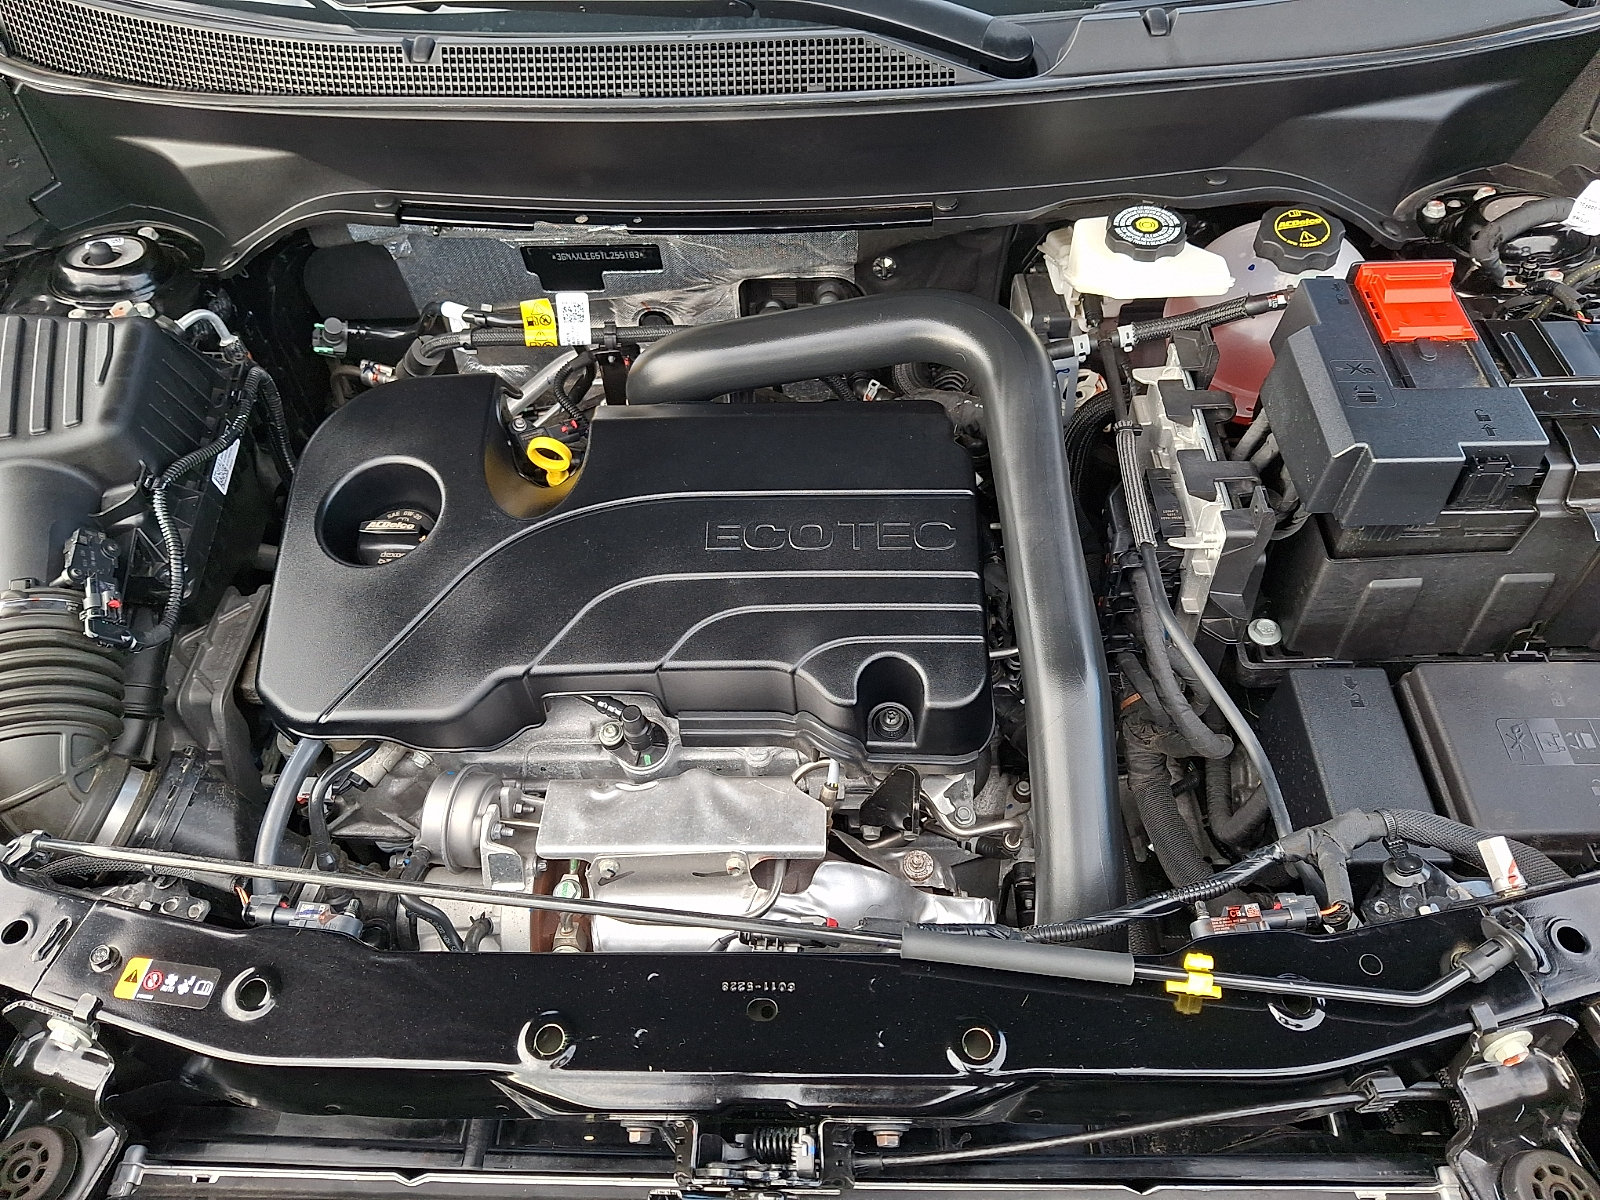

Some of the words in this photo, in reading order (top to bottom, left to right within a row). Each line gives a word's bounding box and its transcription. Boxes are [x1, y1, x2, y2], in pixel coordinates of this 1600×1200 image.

[1277, 217, 1323, 231] ACDelco
[386, 511, 400, 520] SAE
[364, 521, 416, 530] ACDelco
[704, 521, 957, 551] ECOTEC
